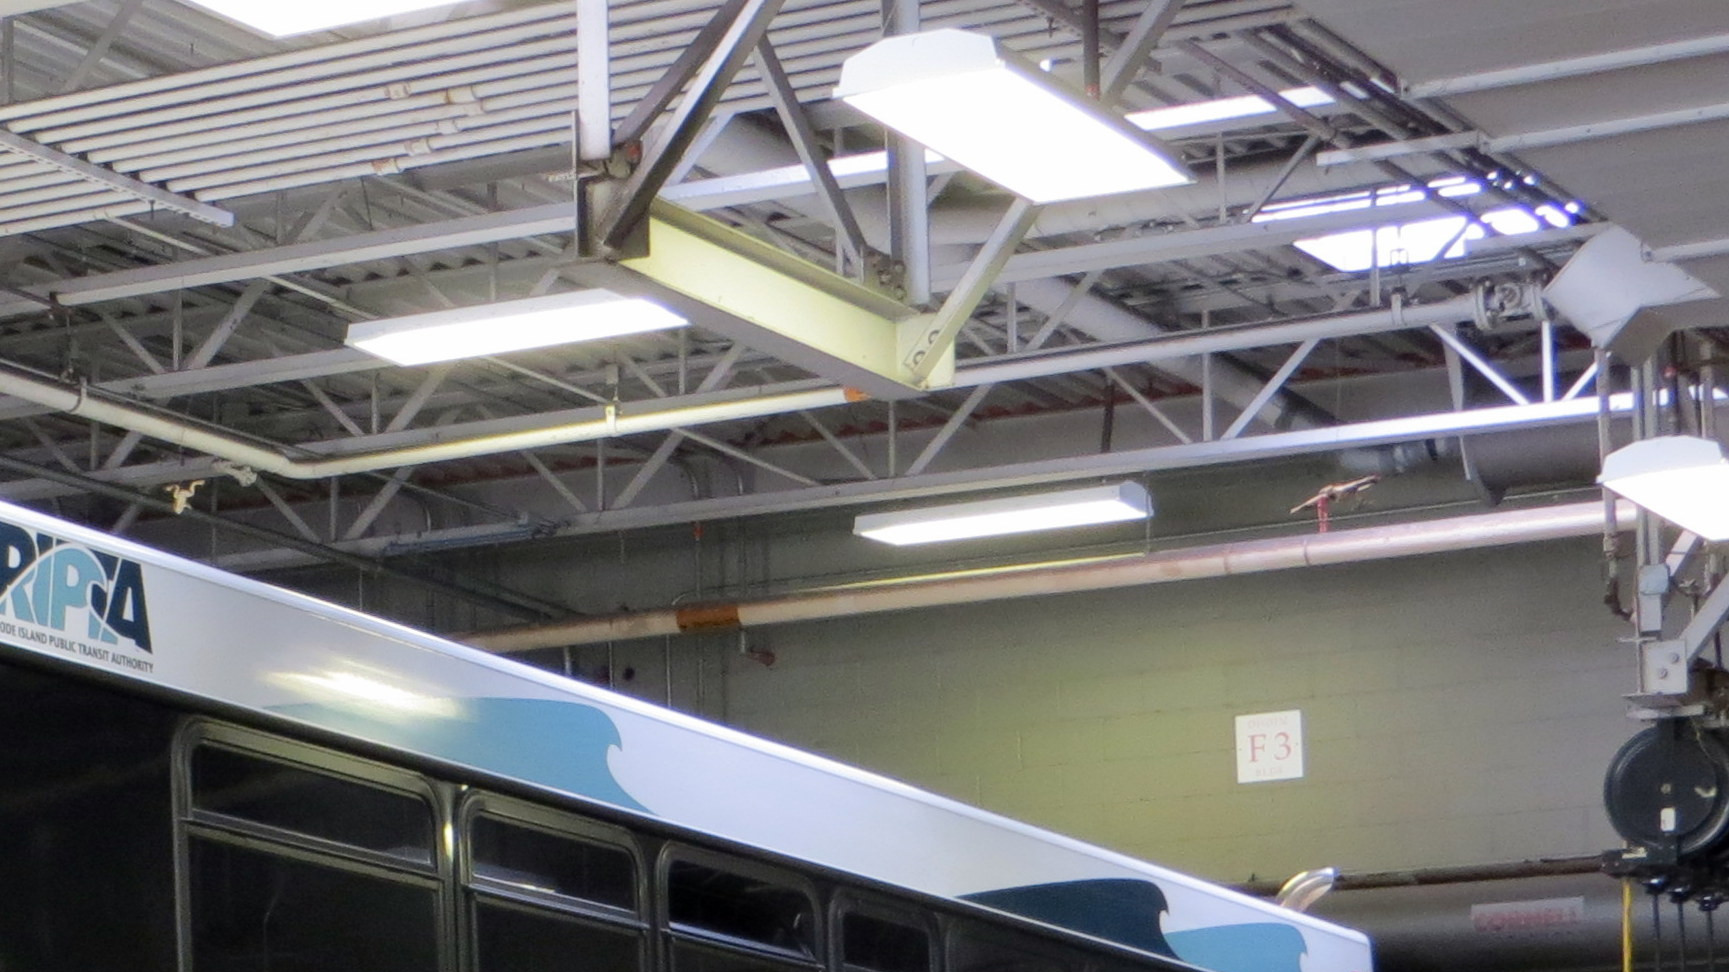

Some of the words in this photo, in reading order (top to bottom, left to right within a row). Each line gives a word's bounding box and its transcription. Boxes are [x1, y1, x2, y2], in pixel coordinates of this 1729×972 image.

[18, 626, 48, 645] ISLAND
[49, 635, 77, 653] PUBLIC
[78, 643, 110, 662] TRANSIT
[111, 650, 154, 674] AUTHORITY
